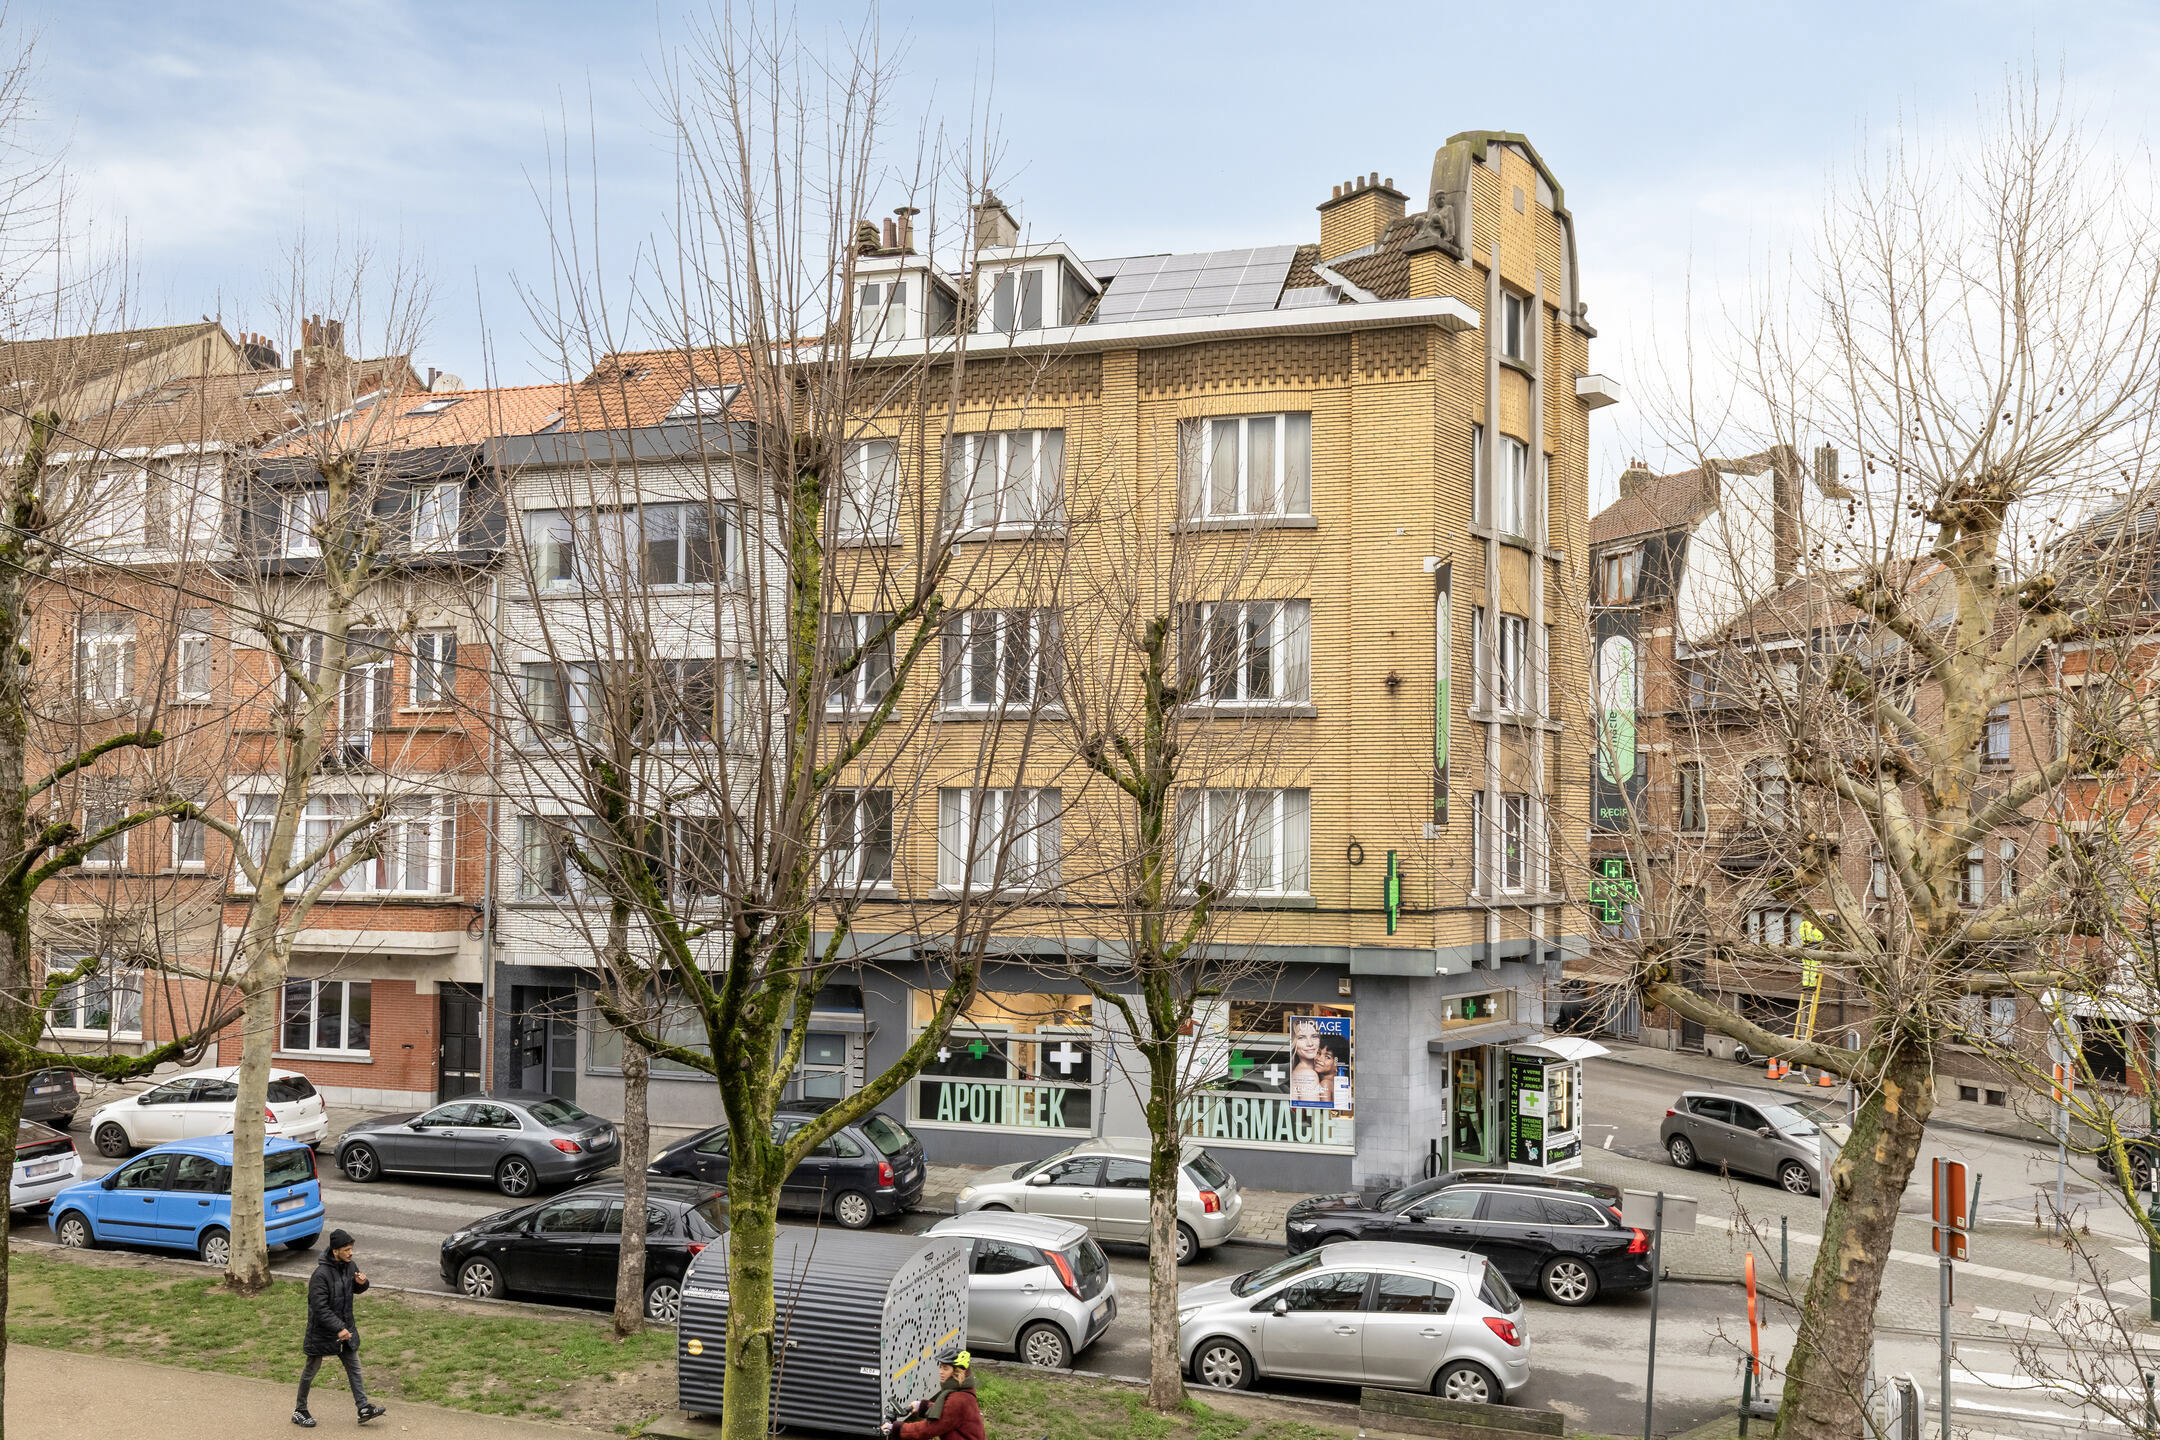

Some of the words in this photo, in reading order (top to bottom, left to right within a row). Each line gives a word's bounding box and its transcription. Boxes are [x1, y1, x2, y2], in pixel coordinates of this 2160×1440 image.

[1299, 1020, 1342, 1032] URIAGE
[937, 1082, 1066, 1129] APOTHEEK
[1176, 1095, 1337, 1144] PHARMACIE
